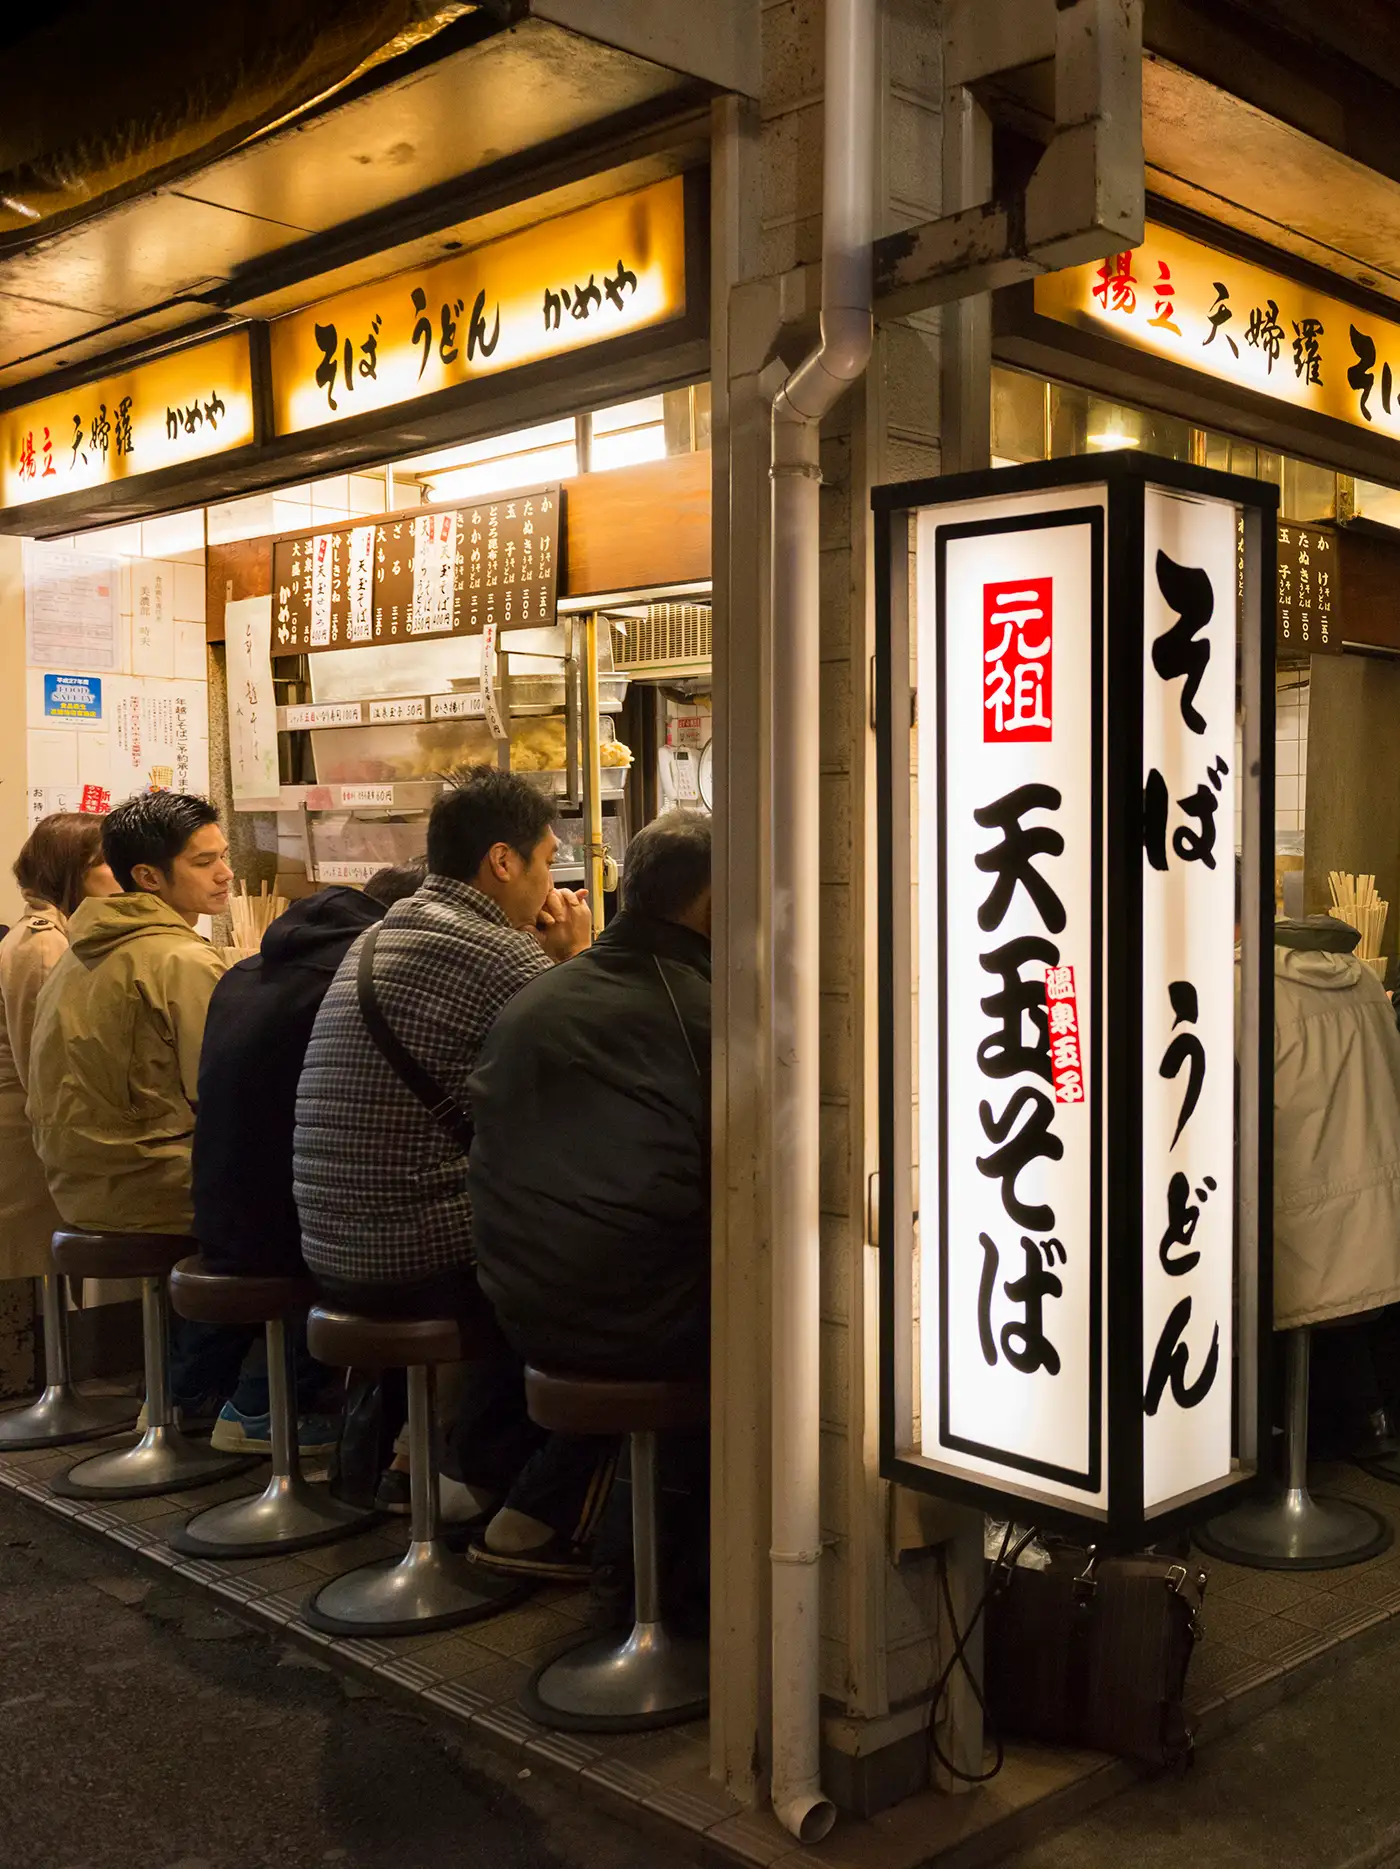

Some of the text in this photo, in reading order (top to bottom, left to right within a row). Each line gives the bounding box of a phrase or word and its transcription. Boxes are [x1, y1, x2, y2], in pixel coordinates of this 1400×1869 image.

[315, 259, 637, 411] そば うどん かめや
[1202, 282, 1324, 387] 天婦羅
[70, 396, 134, 471] 天婦羅
[165, 390, 226, 440] かめや
[391, 524, 402, 576] ざる
[470, 510, 481, 562] わかめ
[487, 506, 499, 561] とろろ昆布
[504, 503, 516, 558] 玉子
[522, 500, 534, 554] たぬき
[540, 497, 552, 552] かけ
[291, 542, 301, 596] 大盛り
[377, 527, 387, 583] 大もり
[437, 544, 450, 612] 天玉そば
[1278, 528, 1291, 580] 玉子
[1298, 532, 1310, 583] たぬき
[1317, 536, 1330, 587] かけ
[277, 585, 291, 645] かめや
[356, 559, 368, 623] 天玉そば
[984, 589, 1052, 738] 元祖
[53, 694, 93, 702] SAFETY
[406, 704, 424, 716] 50円
[1142, 549, 1231, 873] そば
[973, 782, 1067, 1377] 天玉そば
[1142, 981, 1219, 1418] うどん
